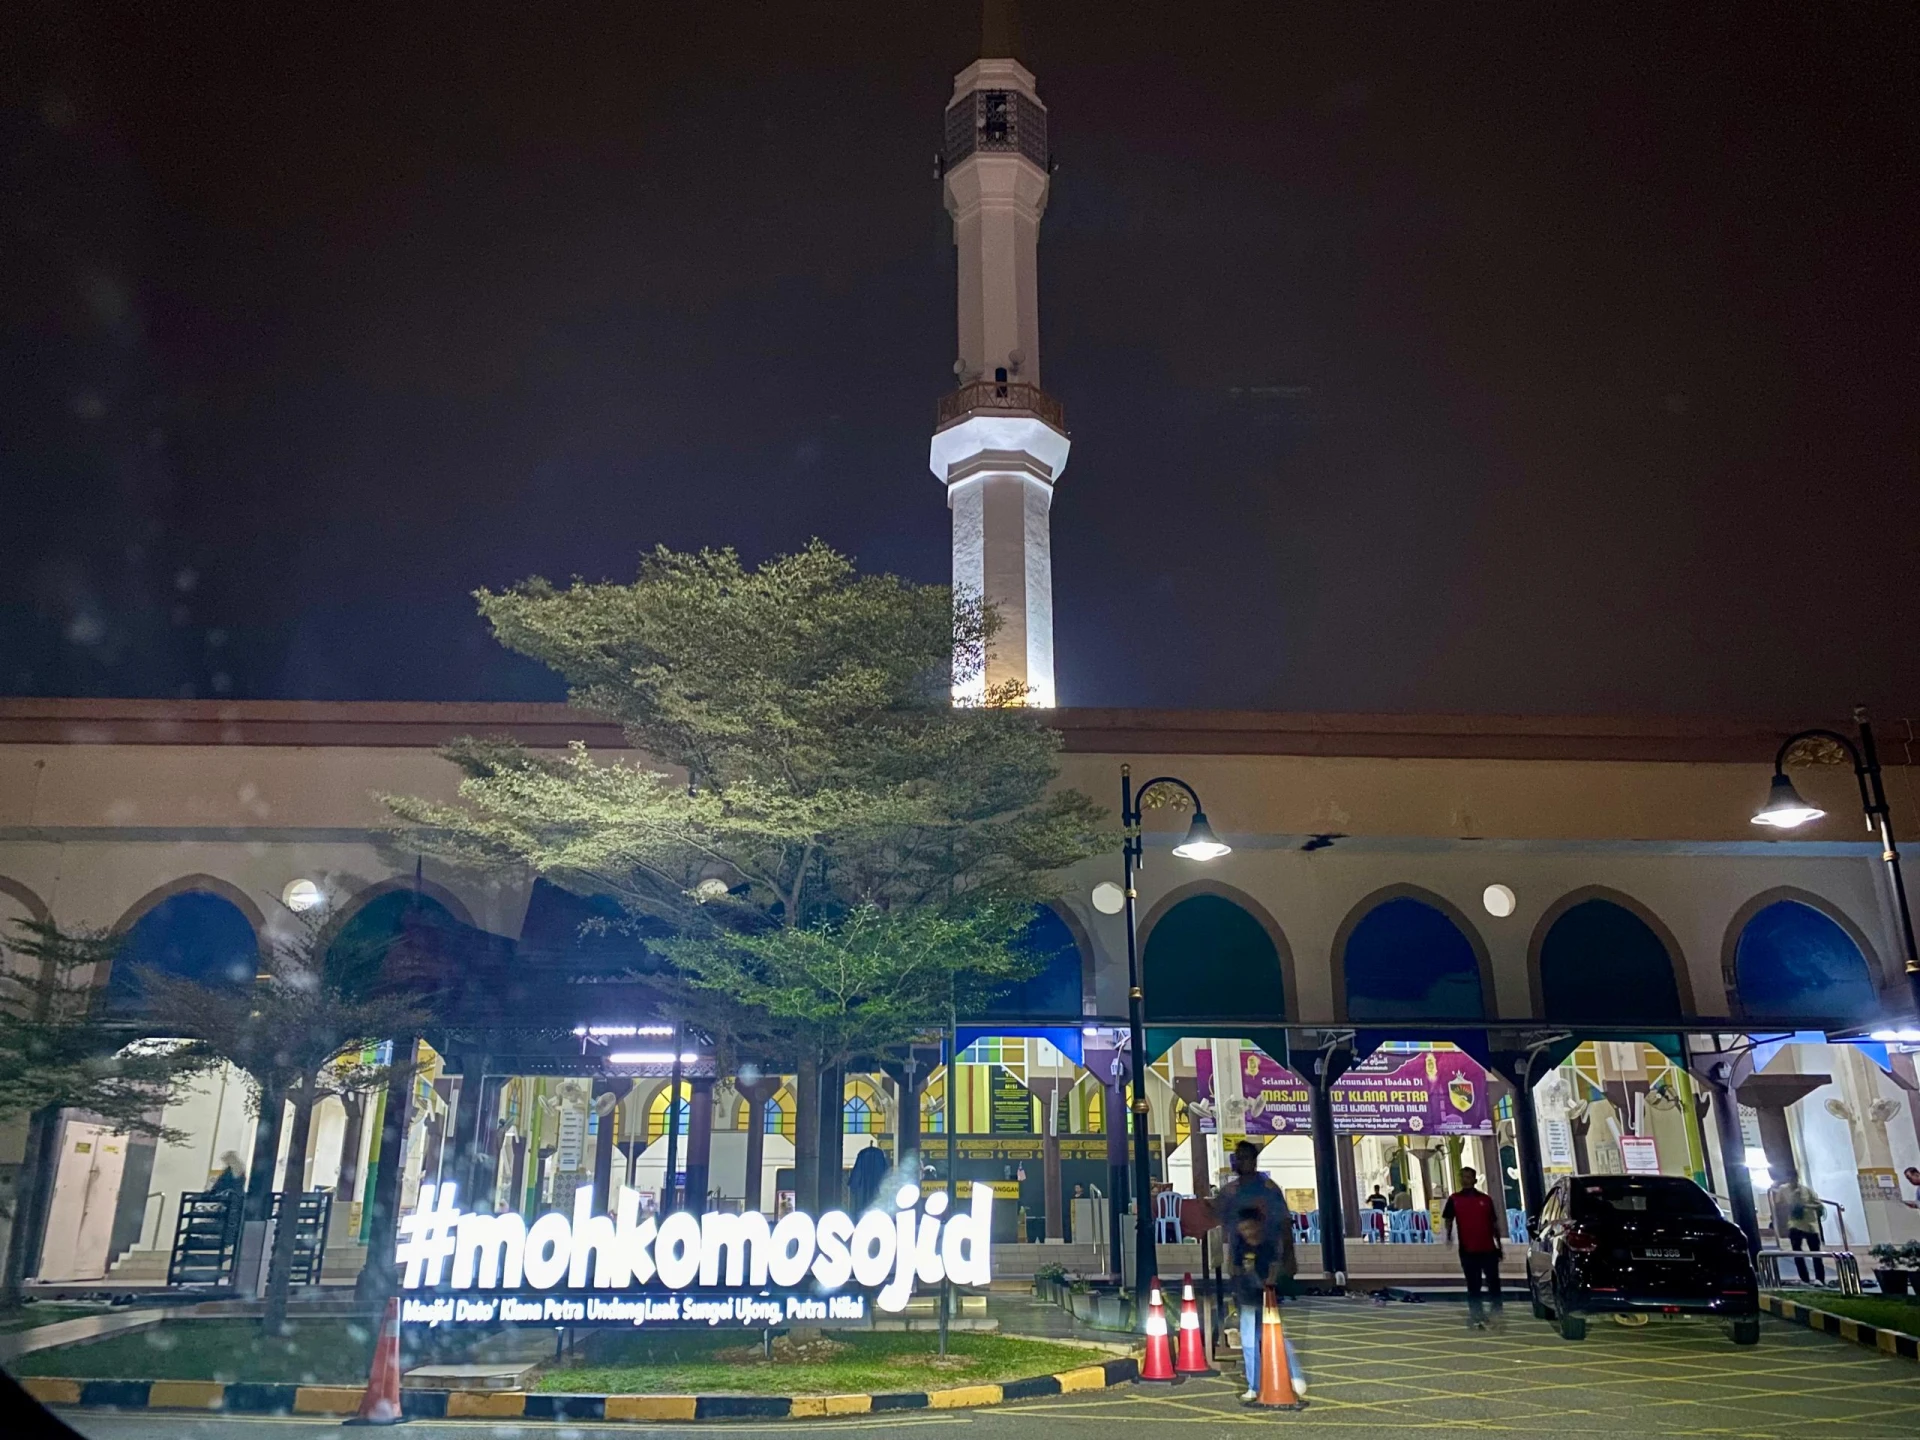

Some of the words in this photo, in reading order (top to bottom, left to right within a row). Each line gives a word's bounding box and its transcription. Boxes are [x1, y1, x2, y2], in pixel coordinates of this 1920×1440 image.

[1262, 1077, 1293, 1086] Selamat
[1385, 1077, 1412, 1086] Ibadah
[1413, 1078, 1423, 1086] Di
[1260, 1089, 1309, 1102] MASJID
[1348, 1090, 1388, 1103] KLANA
[1390, 1090, 1429, 1103] PETRA
[1349, 1104, 1379, 1114] UJONG,
[1380, 1104, 1405, 1113] PUTRA
[1406, 1104, 1427, 1113] NILAI
[396, 1181, 994, 1312] #mohkomosojid
[402, 1298, 454, 1328] Masjid
[455, 1298, 499, 1322] Dato'
[544, 1298, 584, 1321] Petra
[735, 1297, 784, 1326] Ujong,
[786, 1297, 827, 1320] Putra
[829, 1296, 864, 1321] Nilai
